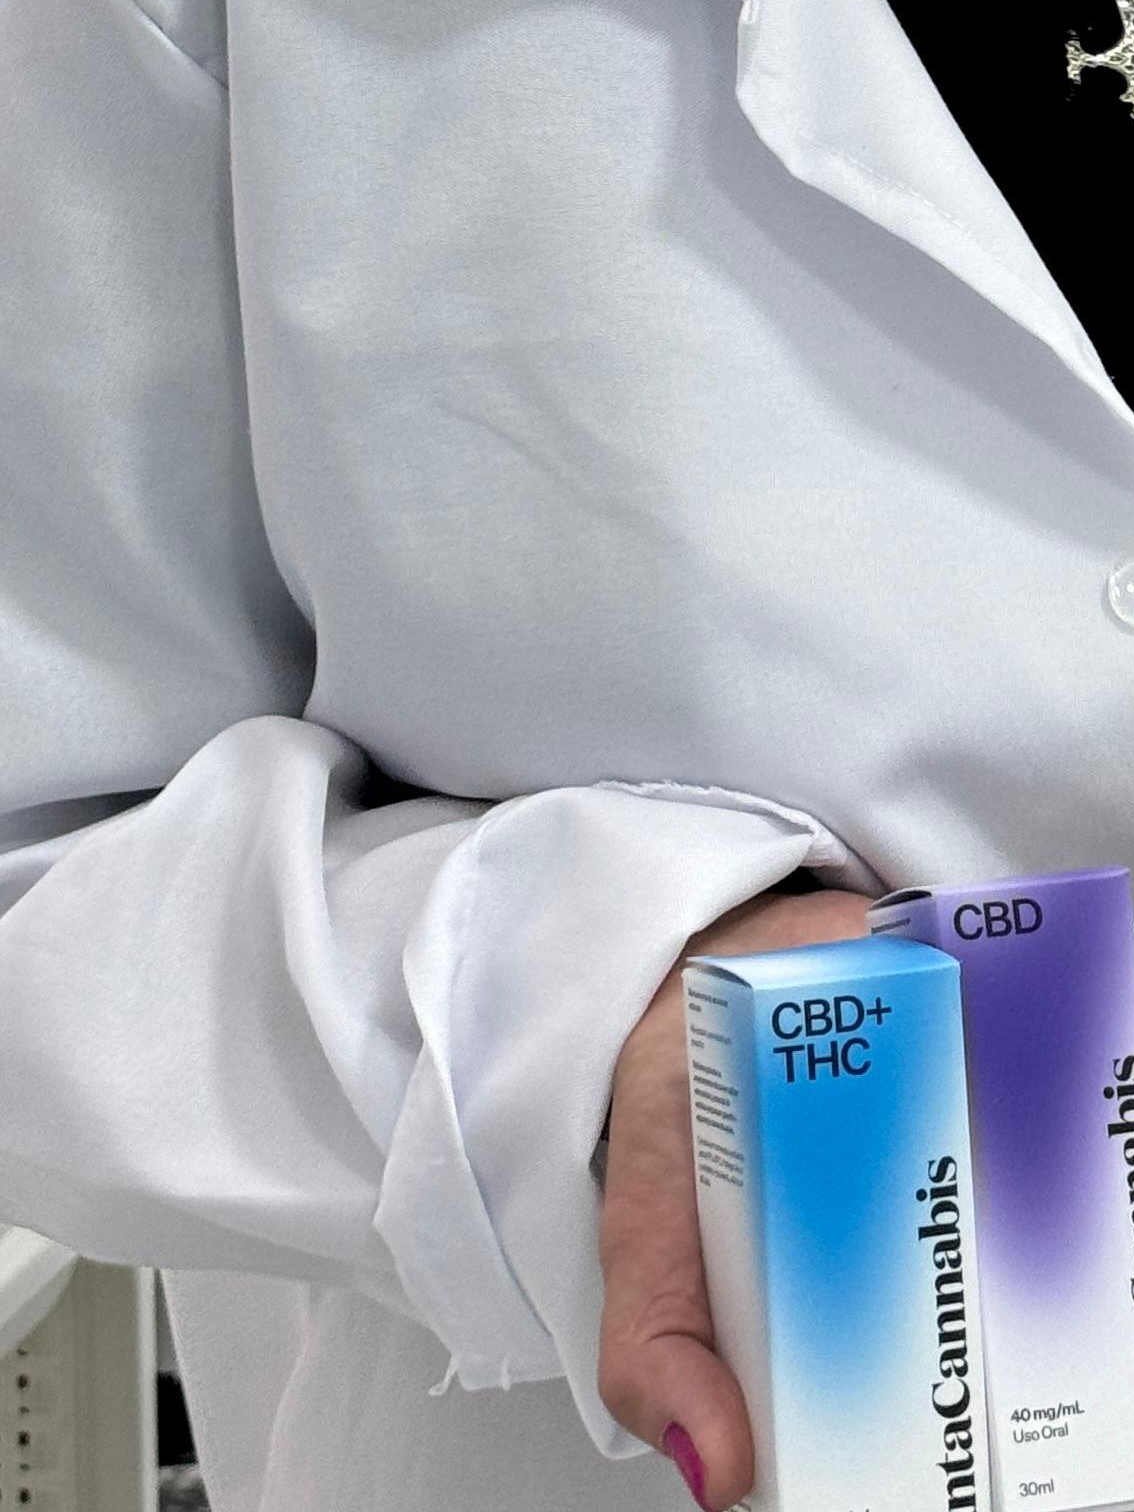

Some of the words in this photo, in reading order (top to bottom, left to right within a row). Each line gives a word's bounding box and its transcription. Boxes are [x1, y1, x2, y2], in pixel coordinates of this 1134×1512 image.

[953, 898, 1044, 941] CBD
[771, 995, 892, 1040] CBD+
[772, 1037, 873, 1084] THC
[915, 1155, 977, 1512] ntaCannabis
[1010, 1408, 1032, 1423] 40
[1033, 1400, 1085, 1422] mg/mL
[1013, 1429, 1040, 1444] Uso
[1041, 1422, 1069, 1440] Oral
[1019, 1477, 1055, 1497] 30ml
